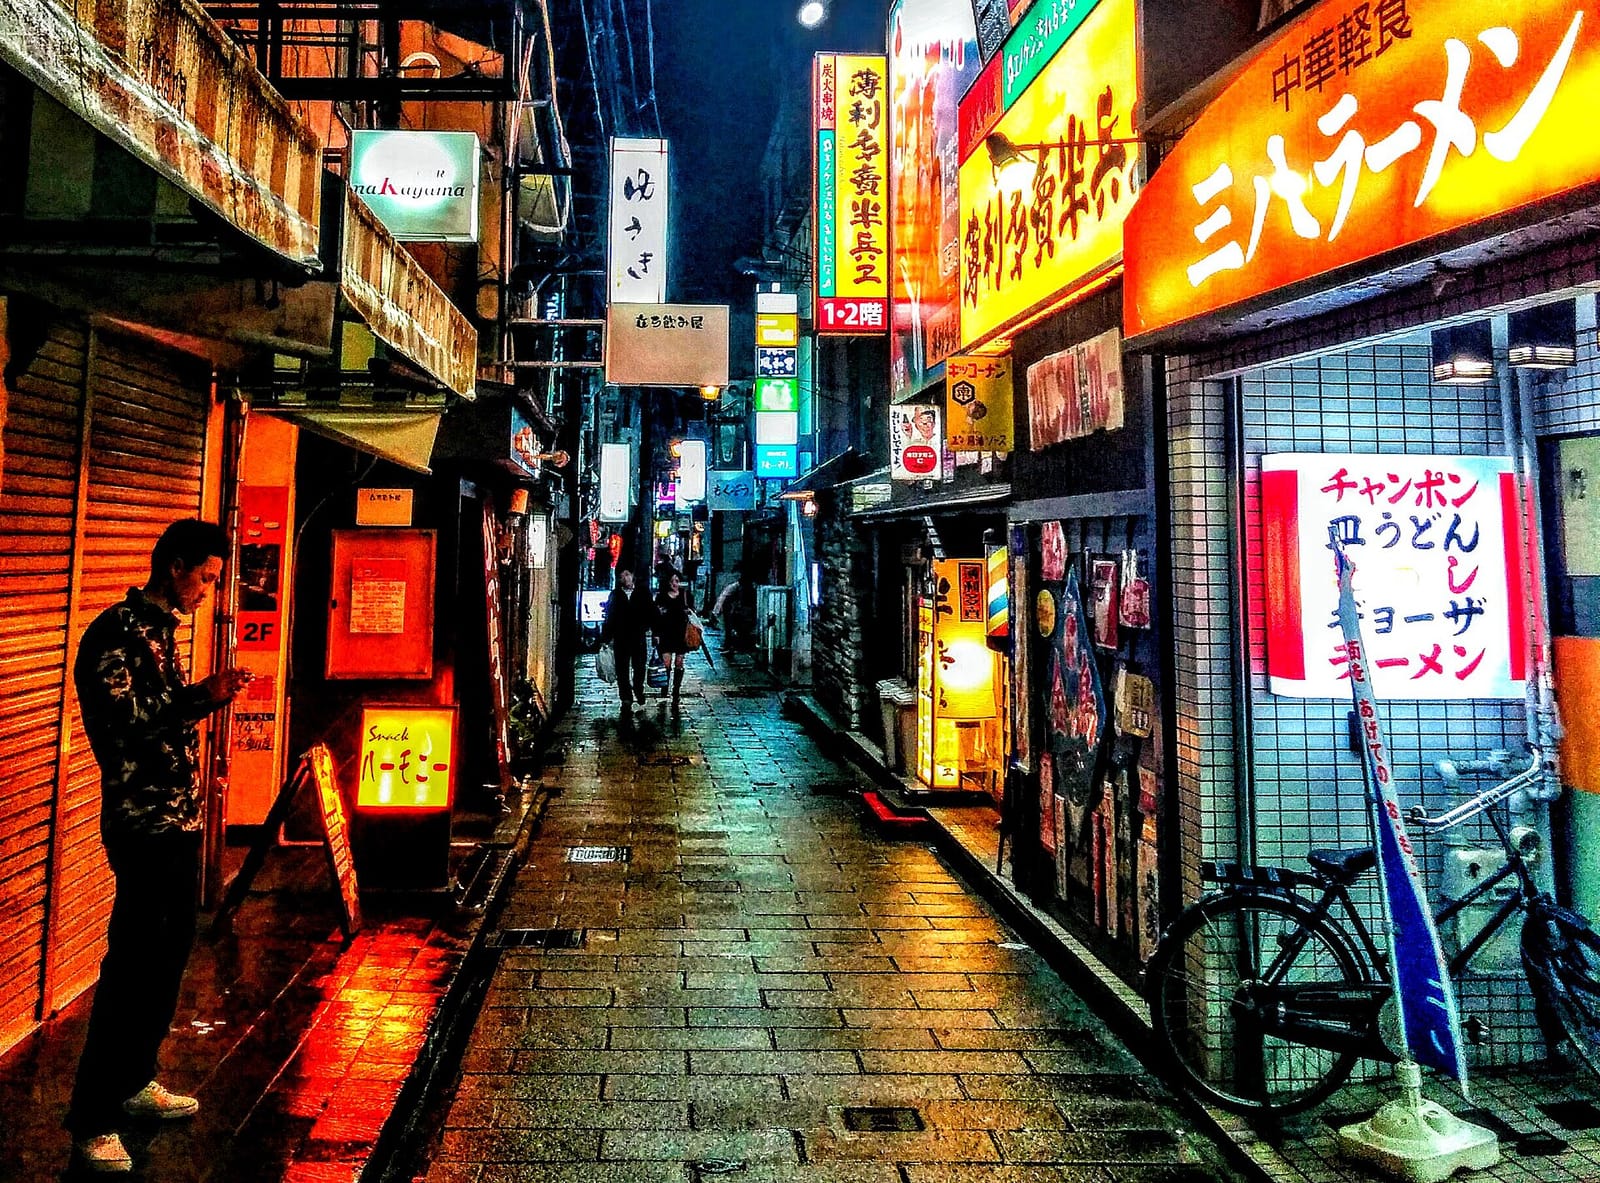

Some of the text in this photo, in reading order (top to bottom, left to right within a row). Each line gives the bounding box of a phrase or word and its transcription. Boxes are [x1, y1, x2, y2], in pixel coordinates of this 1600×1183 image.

[1272, 0, 1412, 113] 中華軽食
[1186, 10, 1584, 288] 三八ラーメン
[623, 168, 655, 280] ゆうき
[635, 313, 704, 330] 立ち飲み屋
[948, 362, 1006, 379] キッコーナン
[1320, 467, 1479, 508] チャンポン
[1325, 512, 1480, 553] 皿うどん
[243, 622, 275, 642] 2F
[368, 725, 409, 742] Snack
[362, 749, 448, 784] ハーモニー
